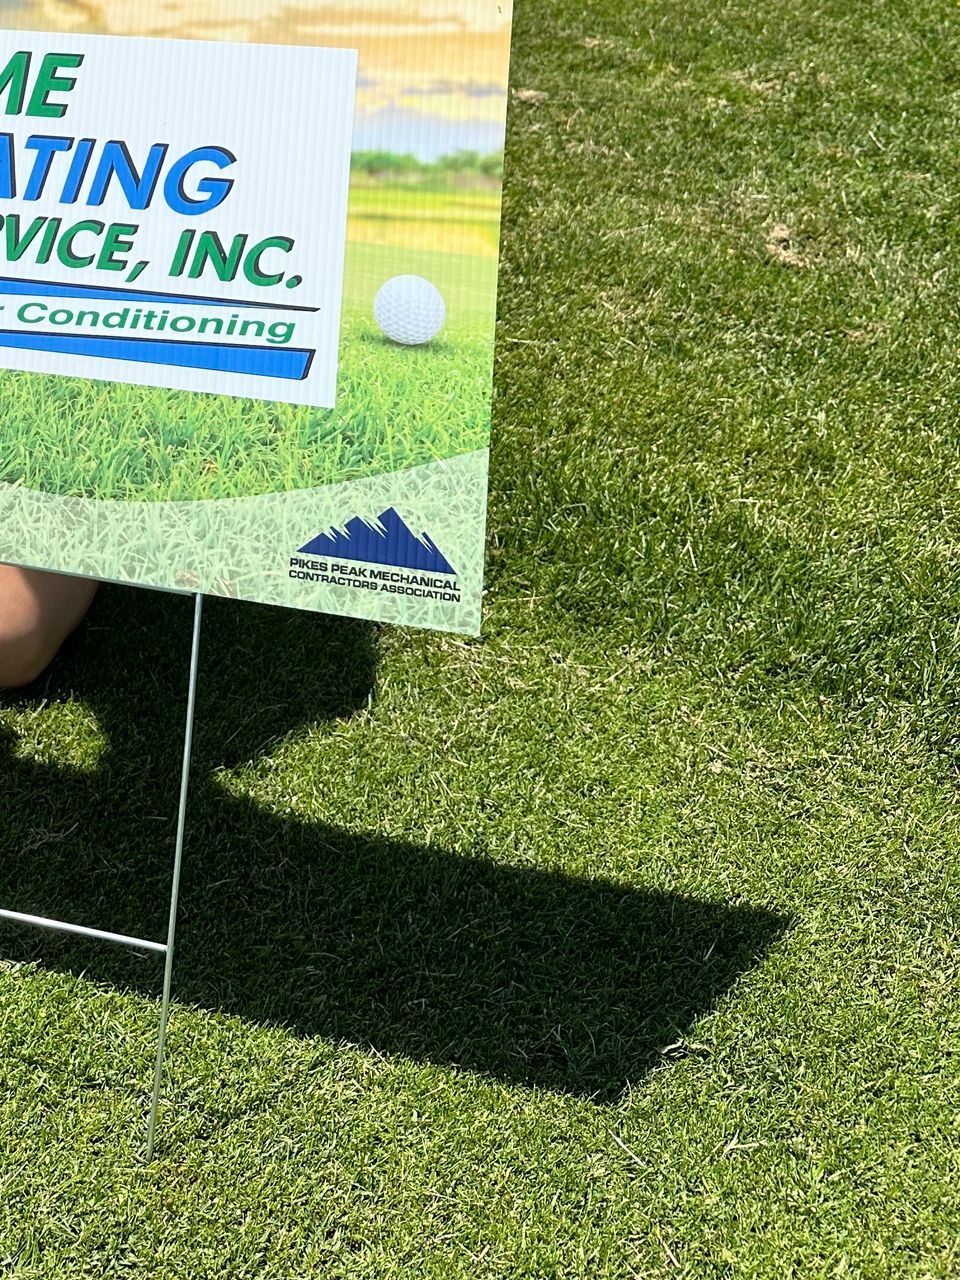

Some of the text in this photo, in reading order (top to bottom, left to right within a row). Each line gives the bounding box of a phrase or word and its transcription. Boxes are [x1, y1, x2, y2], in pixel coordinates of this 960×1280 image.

[168, 229, 302, 289] INC.
[17, 302, 296, 345] Conditioning
[288, 569, 461, 603] CONTRACTORS ASSOCIATION
[289, 557, 461, 592] PIKES PEAK MECHANICAL
